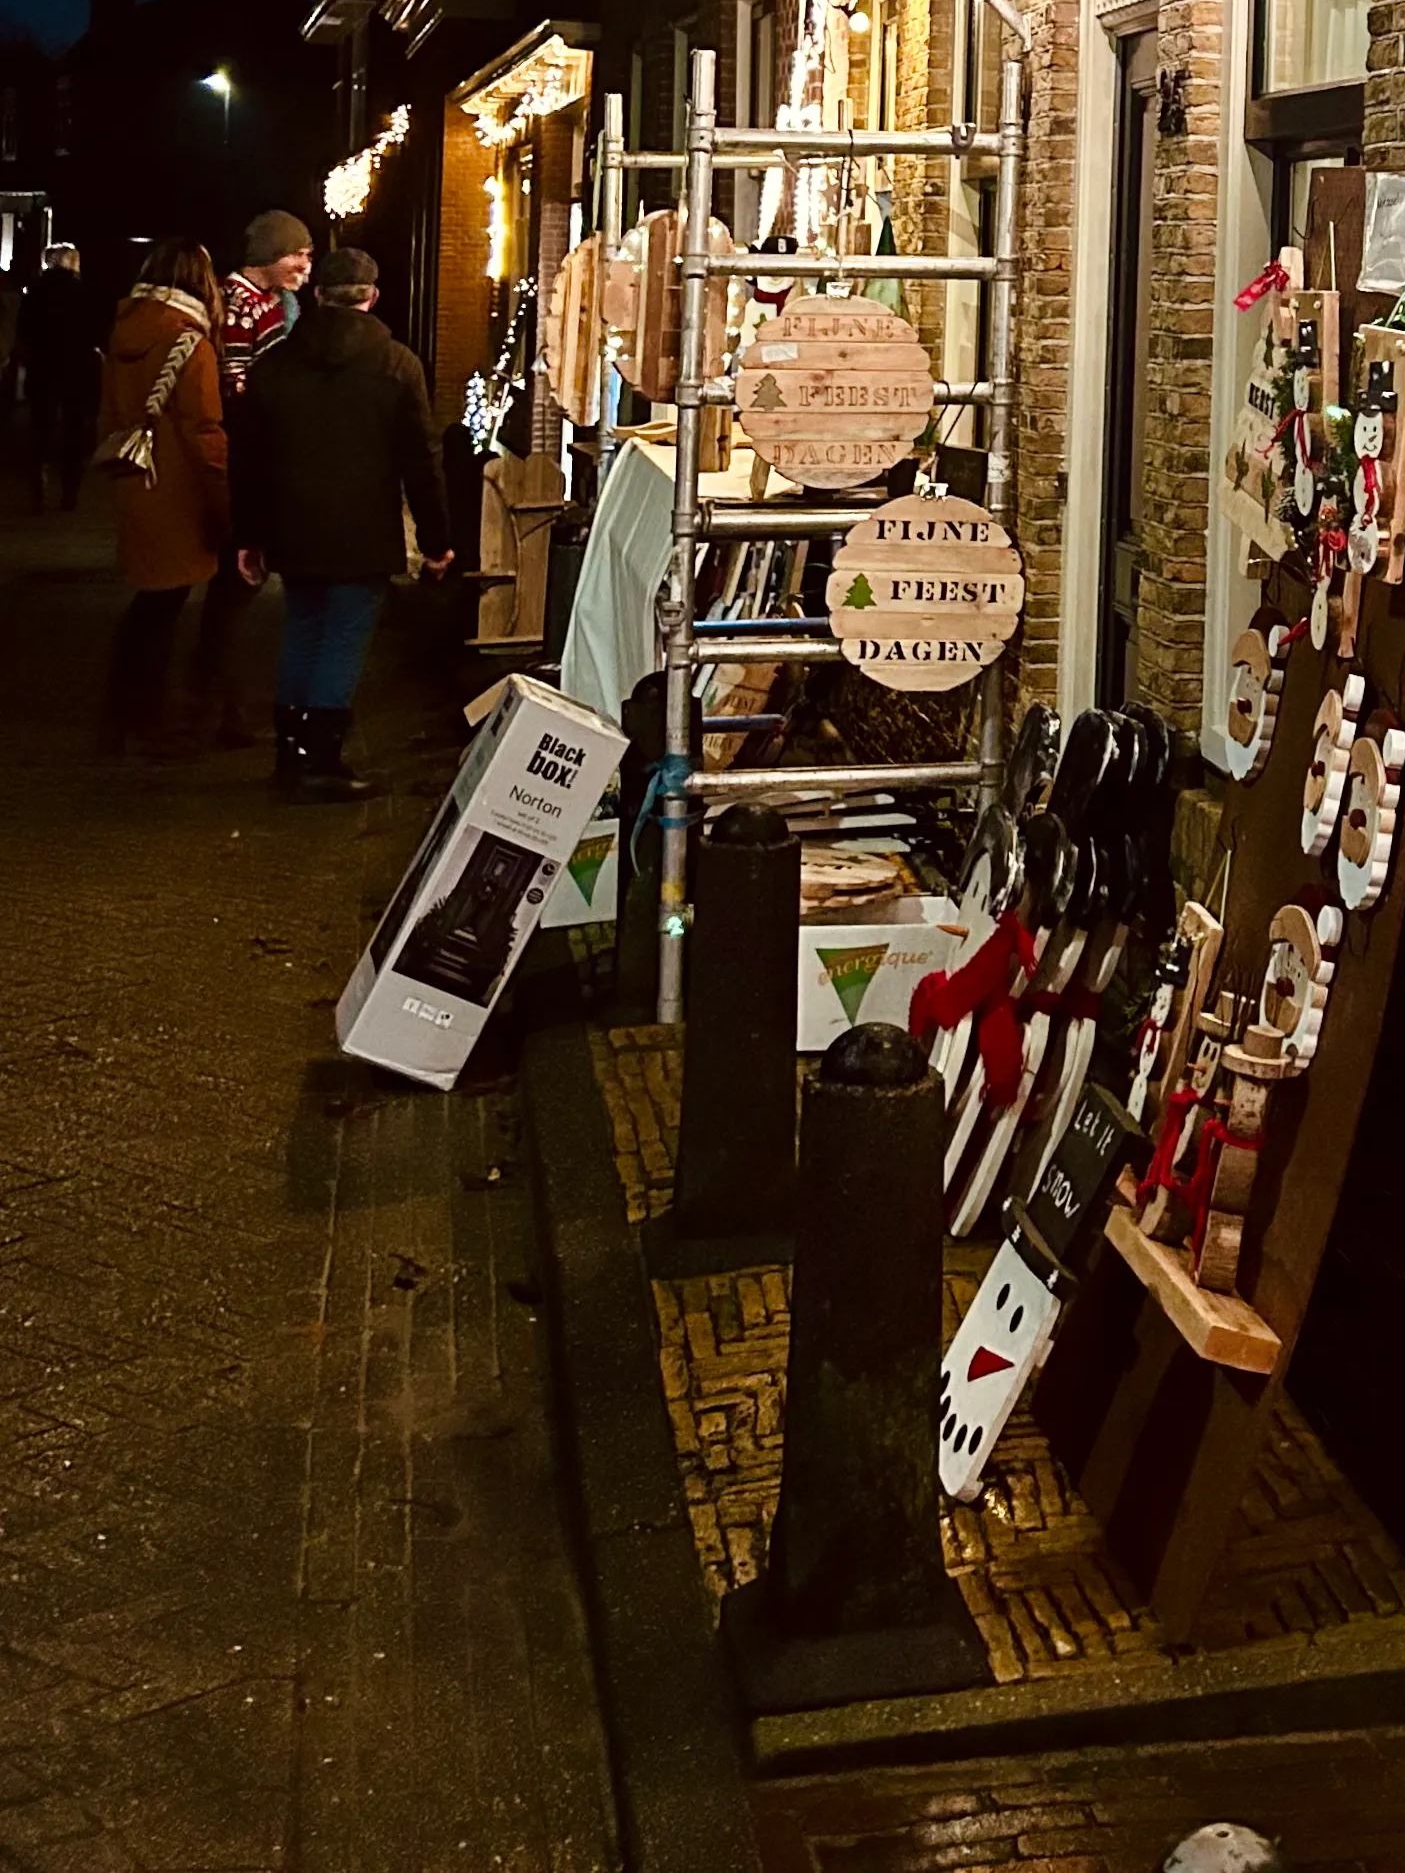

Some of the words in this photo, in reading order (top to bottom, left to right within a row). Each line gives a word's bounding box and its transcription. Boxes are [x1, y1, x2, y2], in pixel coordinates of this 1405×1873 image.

[782, 316, 895, 338] FIJNE
[798, 386, 918, 407] FEEST
[772, 443, 897, 466] DAGEN
[876, 519, 990, 543] FIJNE
[890, 580, 1005, 604] FEEST
[858, 639, 983, 662] DAGEN
[538, 732, 587, 768] Black
[526, 750, 579, 790] box!
[509, 784, 562, 819] Norton
[817, 949, 930, 987] energique
